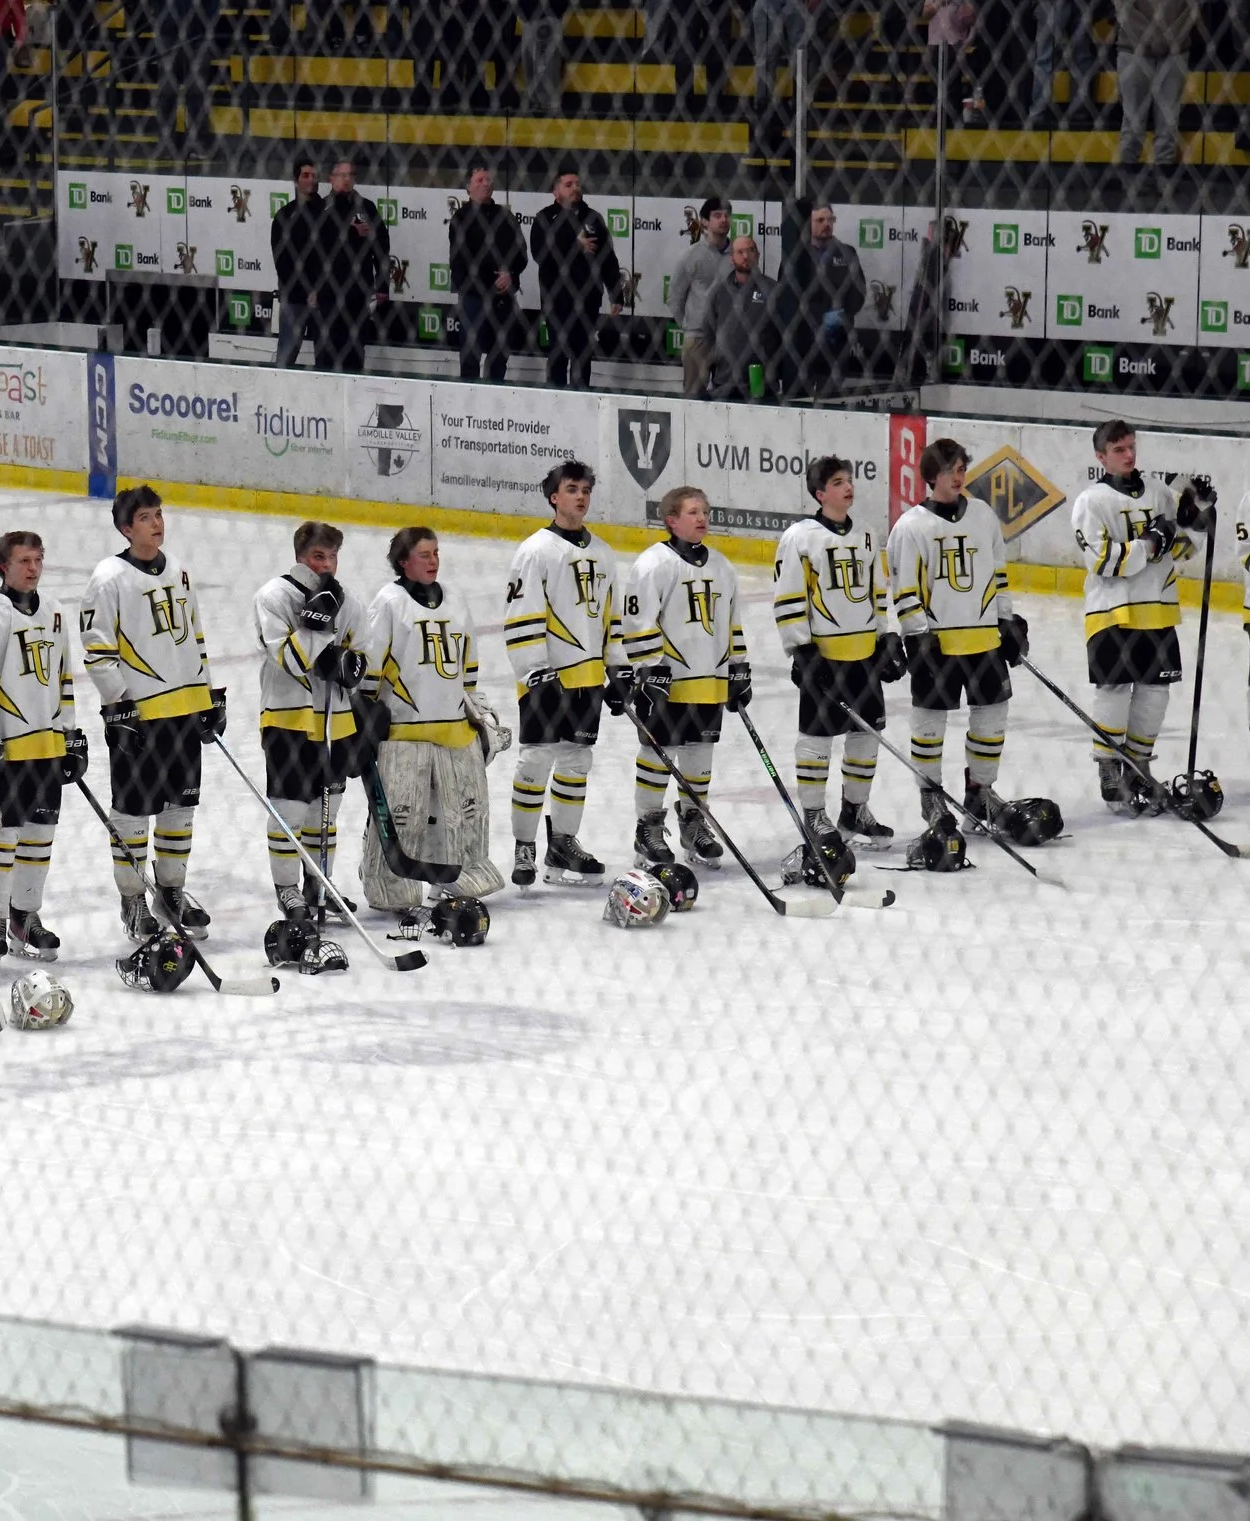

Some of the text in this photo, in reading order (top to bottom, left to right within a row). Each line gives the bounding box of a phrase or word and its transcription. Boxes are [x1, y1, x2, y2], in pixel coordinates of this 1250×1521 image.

[90, 191, 112, 203] Bank
[189, 195, 212, 208] Bank
[401, 207, 427, 220] Bank
[515, 212, 536, 226] Ban
[634, 217, 662, 231] Bank
[758, 222, 782, 236] Ban
[888, 228, 918, 242] Bank
[1023, 232, 1055, 247] Bank
[1166, 237, 1201, 252] Bank
[137, 252, 159, 265] Bank
[238, 257, 262, 271] Bank
[948, 299, 979, 313] Bank
[1088, 305, 1120, 320] Bank
[1233, 311, 1250, 325] Ba
[970, 350, 1006, 366] Bank
[1118, 358, 1156, 375] Bank
[128, 382, 238, 422] Scooore!
[4, 409, 21, 421] BAR
[254, 404, 327, 440] fidium
[441, 413, 550, 436] Your Trusted Provider
[358, 427, 422, 442] LAMOILLE VALLEY
[13, 434, 19, 455] A
[22, 434, 56, 462] TOAST
[441, 436, 574, 460] of Transportation Services
[697, 442, 750, 472] UVM
[864, 532, 872, 552] A
[182, 570, 190, 591] A
[624, 594, 640, 616] 18
[53, 612, 62, 632] A
